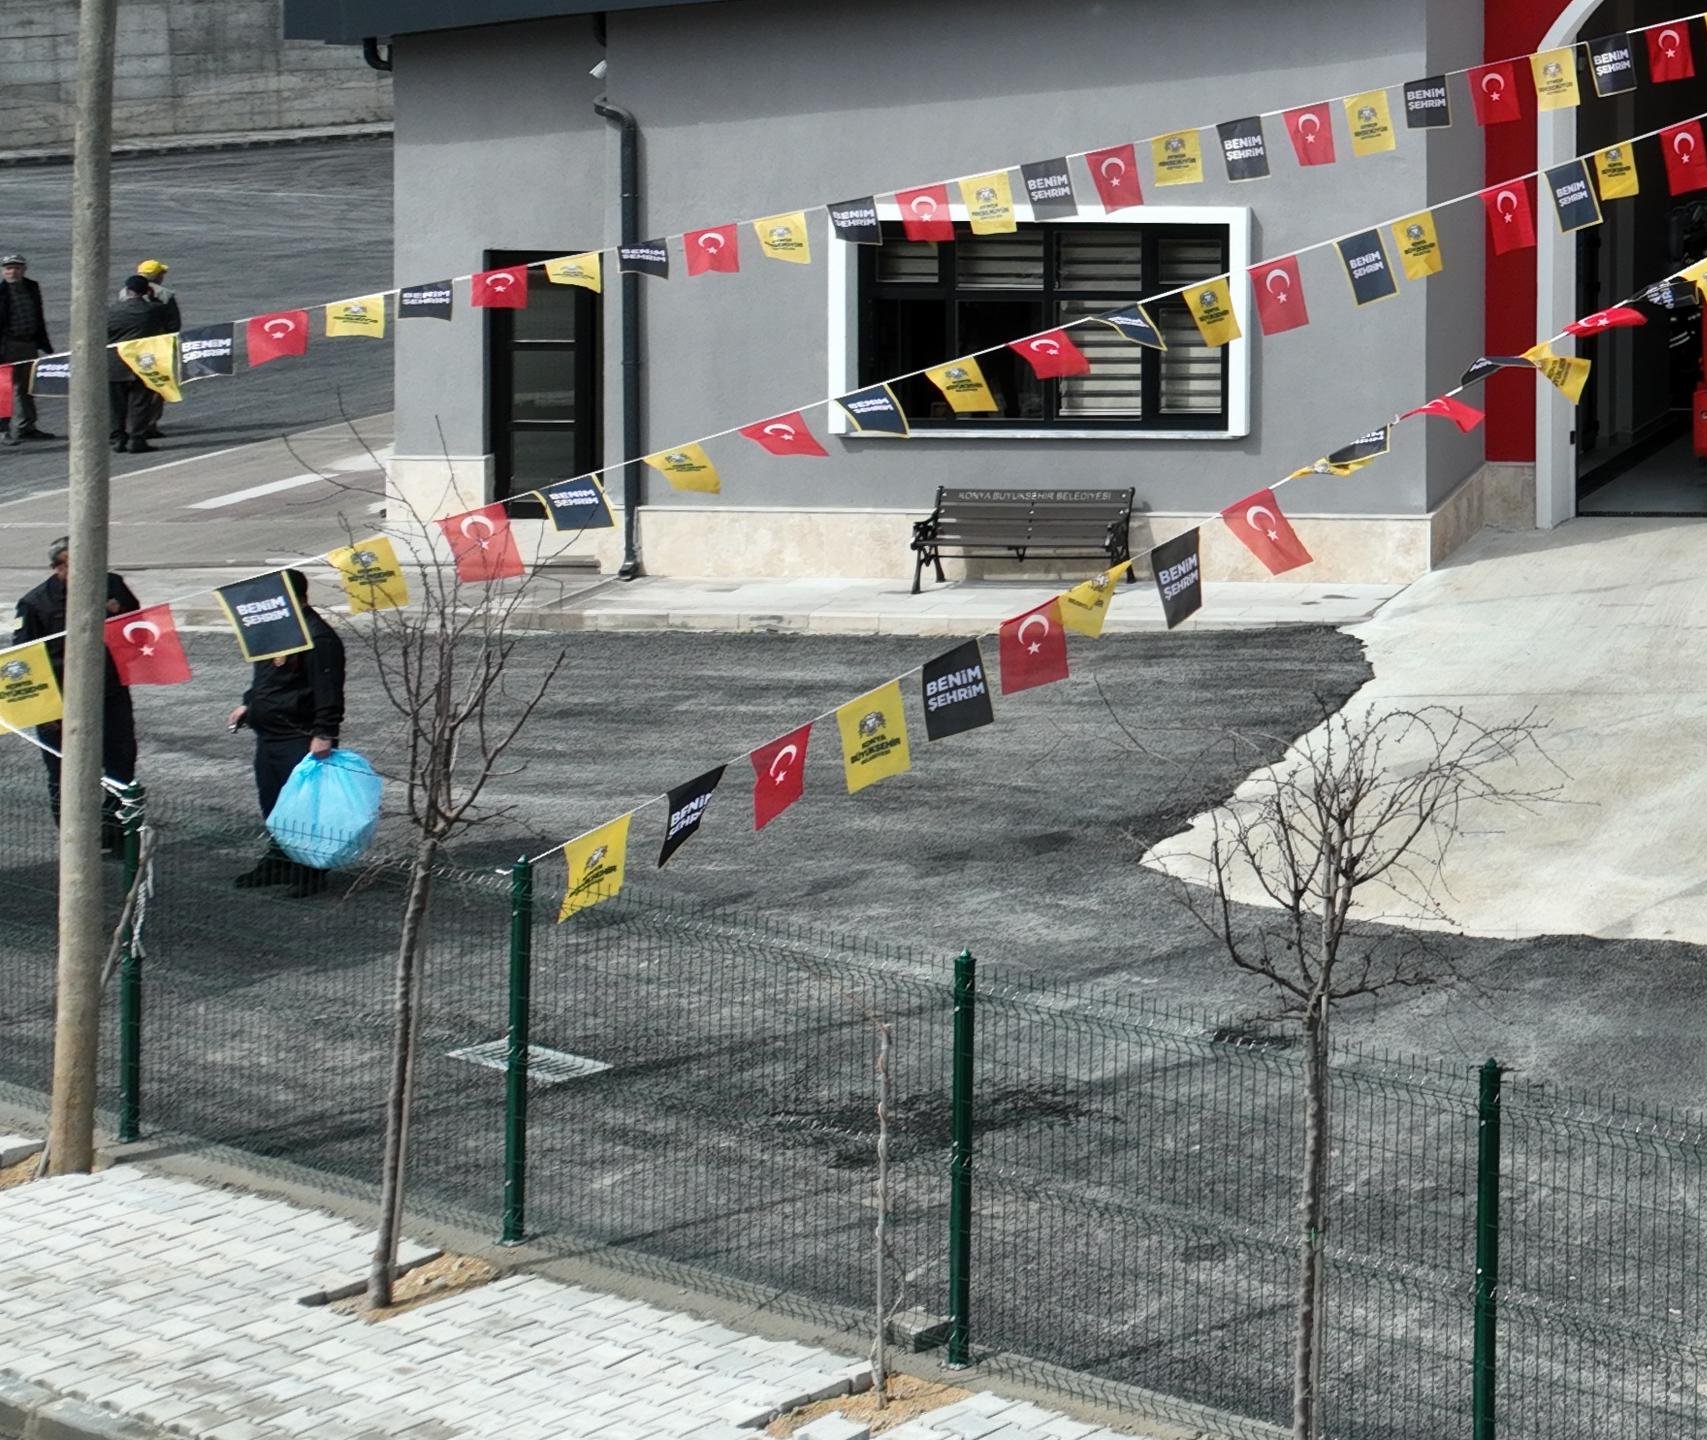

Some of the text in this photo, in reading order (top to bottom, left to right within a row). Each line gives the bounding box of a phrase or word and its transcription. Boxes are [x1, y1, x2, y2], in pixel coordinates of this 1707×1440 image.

[1593, 48, 1629, 65] BENİM
[1406, 87, 1445, 100] BENİM
[1224, 135, 1263, 150] BENİM
[1226, 146, 1265, 161] ŞEHRİM
[1027, 174, 1069, 191] BENİM
[1158, 554, 1197, 586] BENİM
[1163, 571, 1199, 601] ŞEHRİM
[925, 665, 982, 697] BENİM
[927, 682, 985, 711] ŞEHRİM
